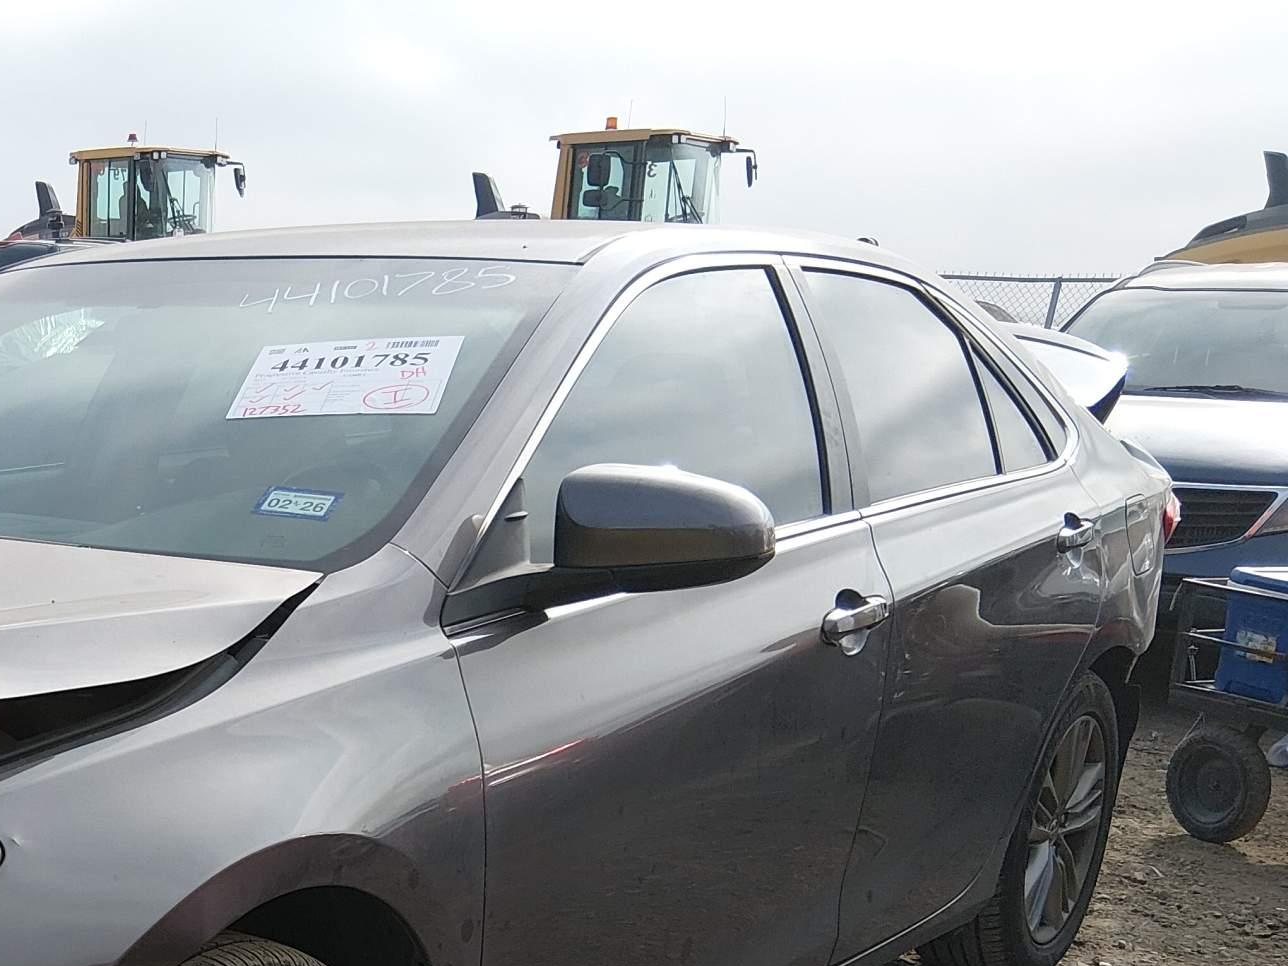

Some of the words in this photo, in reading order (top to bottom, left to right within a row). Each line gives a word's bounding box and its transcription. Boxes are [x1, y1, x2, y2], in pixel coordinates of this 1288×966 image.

[239, 265, 516, 313] 44101785
[271, 352, 432, 372] 44101785
[267, 498, 292, 509] 02
[299, 501, 326, 513] 26
